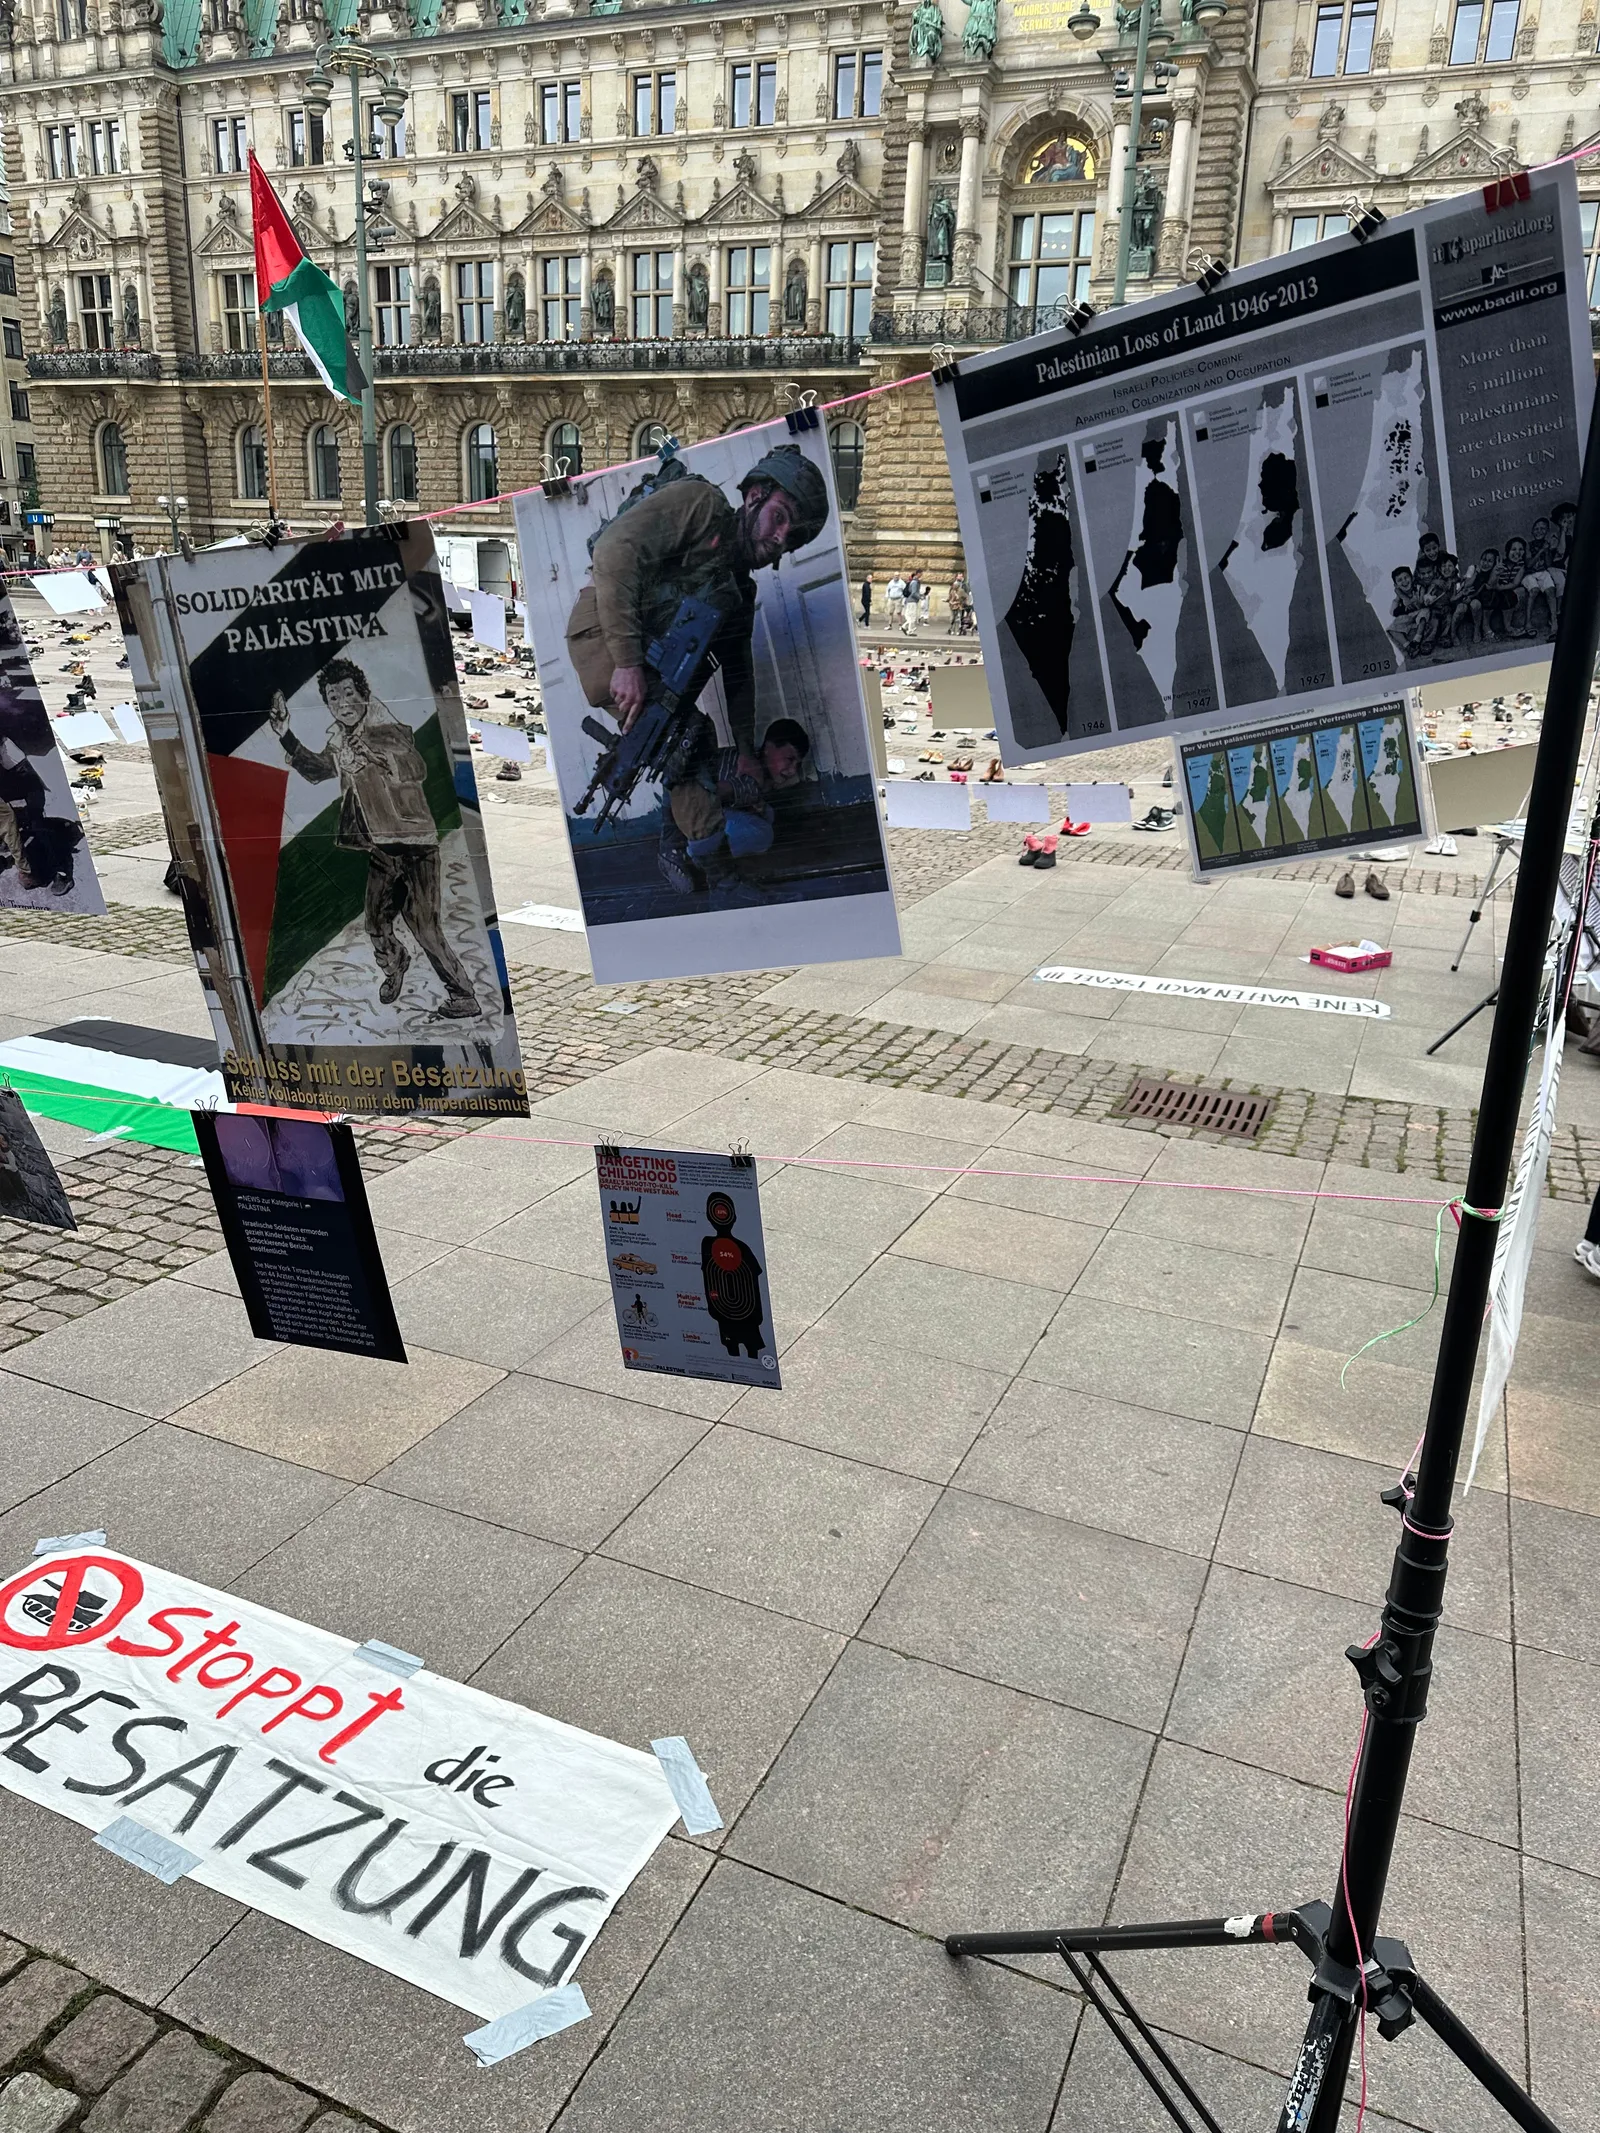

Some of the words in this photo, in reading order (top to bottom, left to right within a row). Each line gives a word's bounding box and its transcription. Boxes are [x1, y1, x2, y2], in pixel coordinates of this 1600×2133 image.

[1441, 281, 1558, 323] www.badil.org
[1035, 343, 1121, 383] Palestinian
[1123, 329, 1160, 356] Loss
[1162, 317, 1181, 343] of
[1183, 303, 1227, 338] Land
[1229, 275, 1320, 323] 1946-2013
[1459, 346, 1504, 369] More
[1509, 333, 1548, 353] than
[1467, 381, 1477, 394] 5
[1483, 364, 1545, 391] million
[1458, 392, 1560, 426] Palestinians
[1458, 437, 1485, 455] are
[1489, 415, 1565, 446] classified
[1471, 465, 1490, 481] by
[1496, 457, 1523, 474] the
[1527, 446, 1558, 466] UN
[1468, 496, 1485, 509] as
[1491, 475, 1564, 503] Refugees
[32, 514, 38, 523] U
[176, 570, 344, 616] SOLIDARITÄT
[351, 562, 402, 593] MIT
[224, 611, 388, 654] PALÄSTINA
[1362, 659, 1391, 675] 2013
[1300, 672, 1327, 687] 1967
[1187, 696, 1211, 710] 1947
[1081, 719, 1105, 732] 1946
[1183, 744, 1196, 753] Der
[1197, 738, 1222, 751] Verlust
[1223, 726, 1289, 747] palästinensischen
[1290, 719, 1318, 732] Landes
[1319, 710, 1367, 728] (Vertreibung
[1372, 702, 1401, 714] Nakba)
[1308, 996, 1380, 1015] KEINE
[225, 1049, 301, 1082] Schluss
[306, 1061, 340, 1086] mit
[346, 1059, 386, 1088] der
[391, 1060, 527, 1096] Besatzung
[231, 1080, 265, 1099] Keine
[267, 1082, 351, 1108] Kollaboration
[355, 1091, 378, 1109] mit
[382, 1092, 414, 1110] dem
[418, 1093, 530, 1113] Imperialismus
[597, 1153, 676, 1171] TARGETING
[598, 1166, 677, 1184] CHILDHOOD
[625, 1180, 673, 1190] SHOOT-TO-KILL
[600, 1183, 623, 1192] POLICY
[630, 1186, 643, 1194] THE
[644, 1187, 661, 1195] WEST
[661, 1188, 680, 1197] BANK
[666, 1211, 682, 1219] Head
[671, 1253, 688, 1261] Torso
[676, 1293, 701, 1302] Multiple
[677, 1299, 695, 1307] Areas
[682, 1333, 700, 1341] Limbs
[106, 1606, 405, 1764] Stoppt
[423, 1745, 516, 1808] die
[0, 1662, 610, 1989] BESATZUNG
